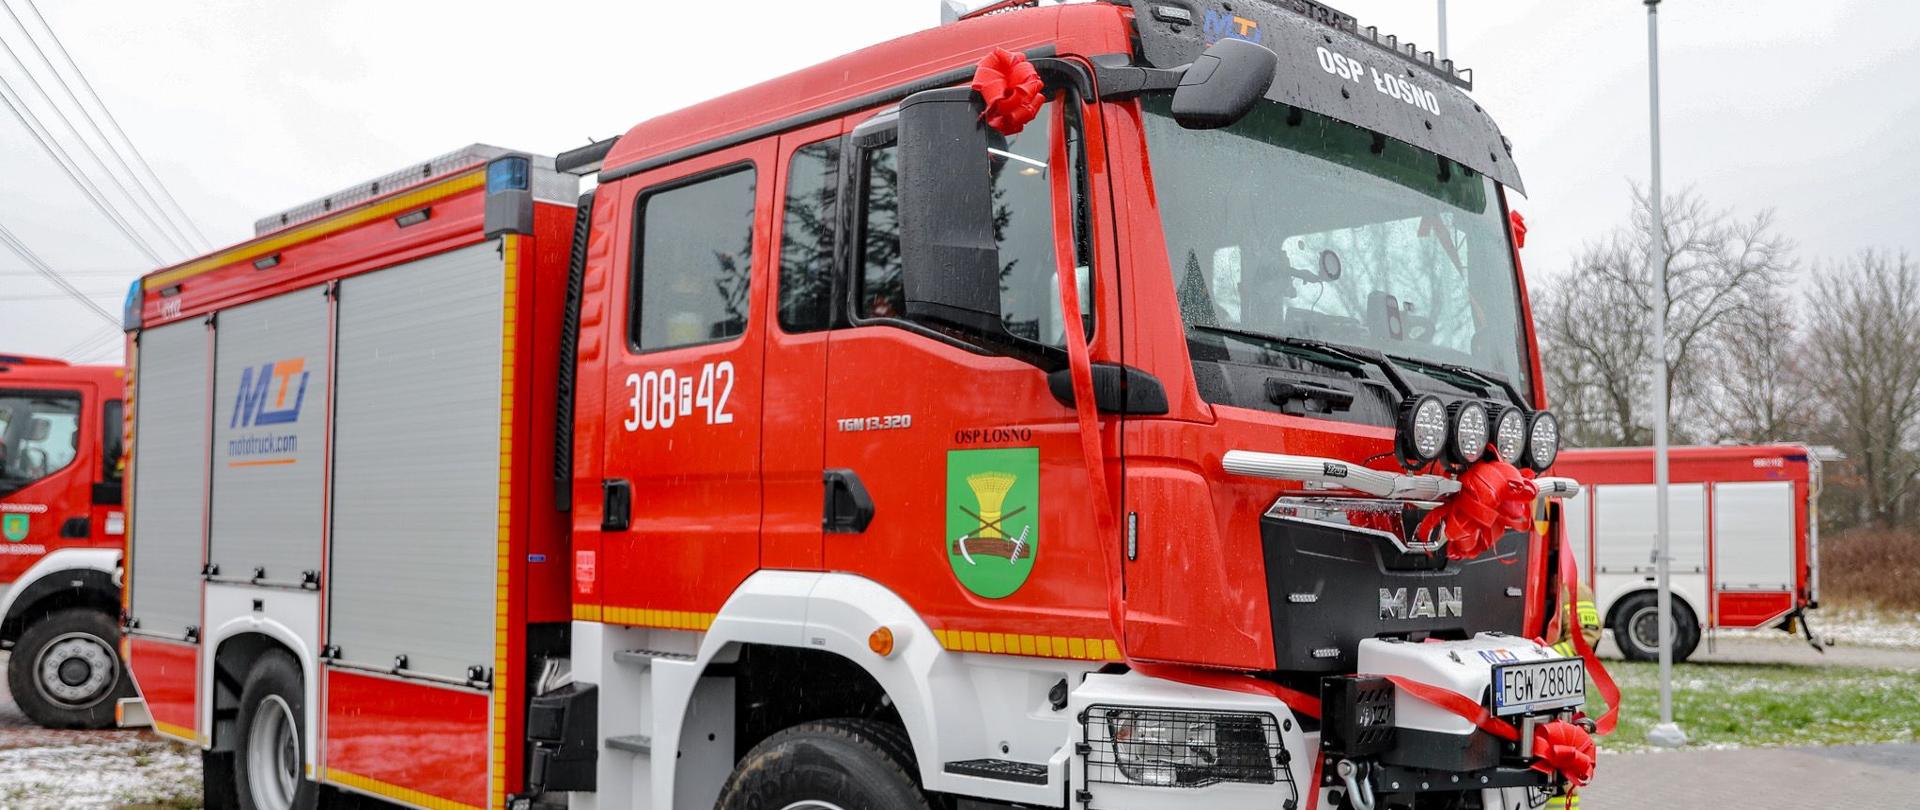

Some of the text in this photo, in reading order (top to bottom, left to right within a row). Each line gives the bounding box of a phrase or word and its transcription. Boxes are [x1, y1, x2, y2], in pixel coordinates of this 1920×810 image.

[1316, 46, 1440, 116] OSP ŁOŚNO
[837, 414, 912, 432] TGM 13.320
[955, 429, 981, 444] OSP
[229, 434, 298, 457] mototruck.com
[1379, 586, 1463, 620] MAN
[1504, 664, 1582, 704] FGW 28802
